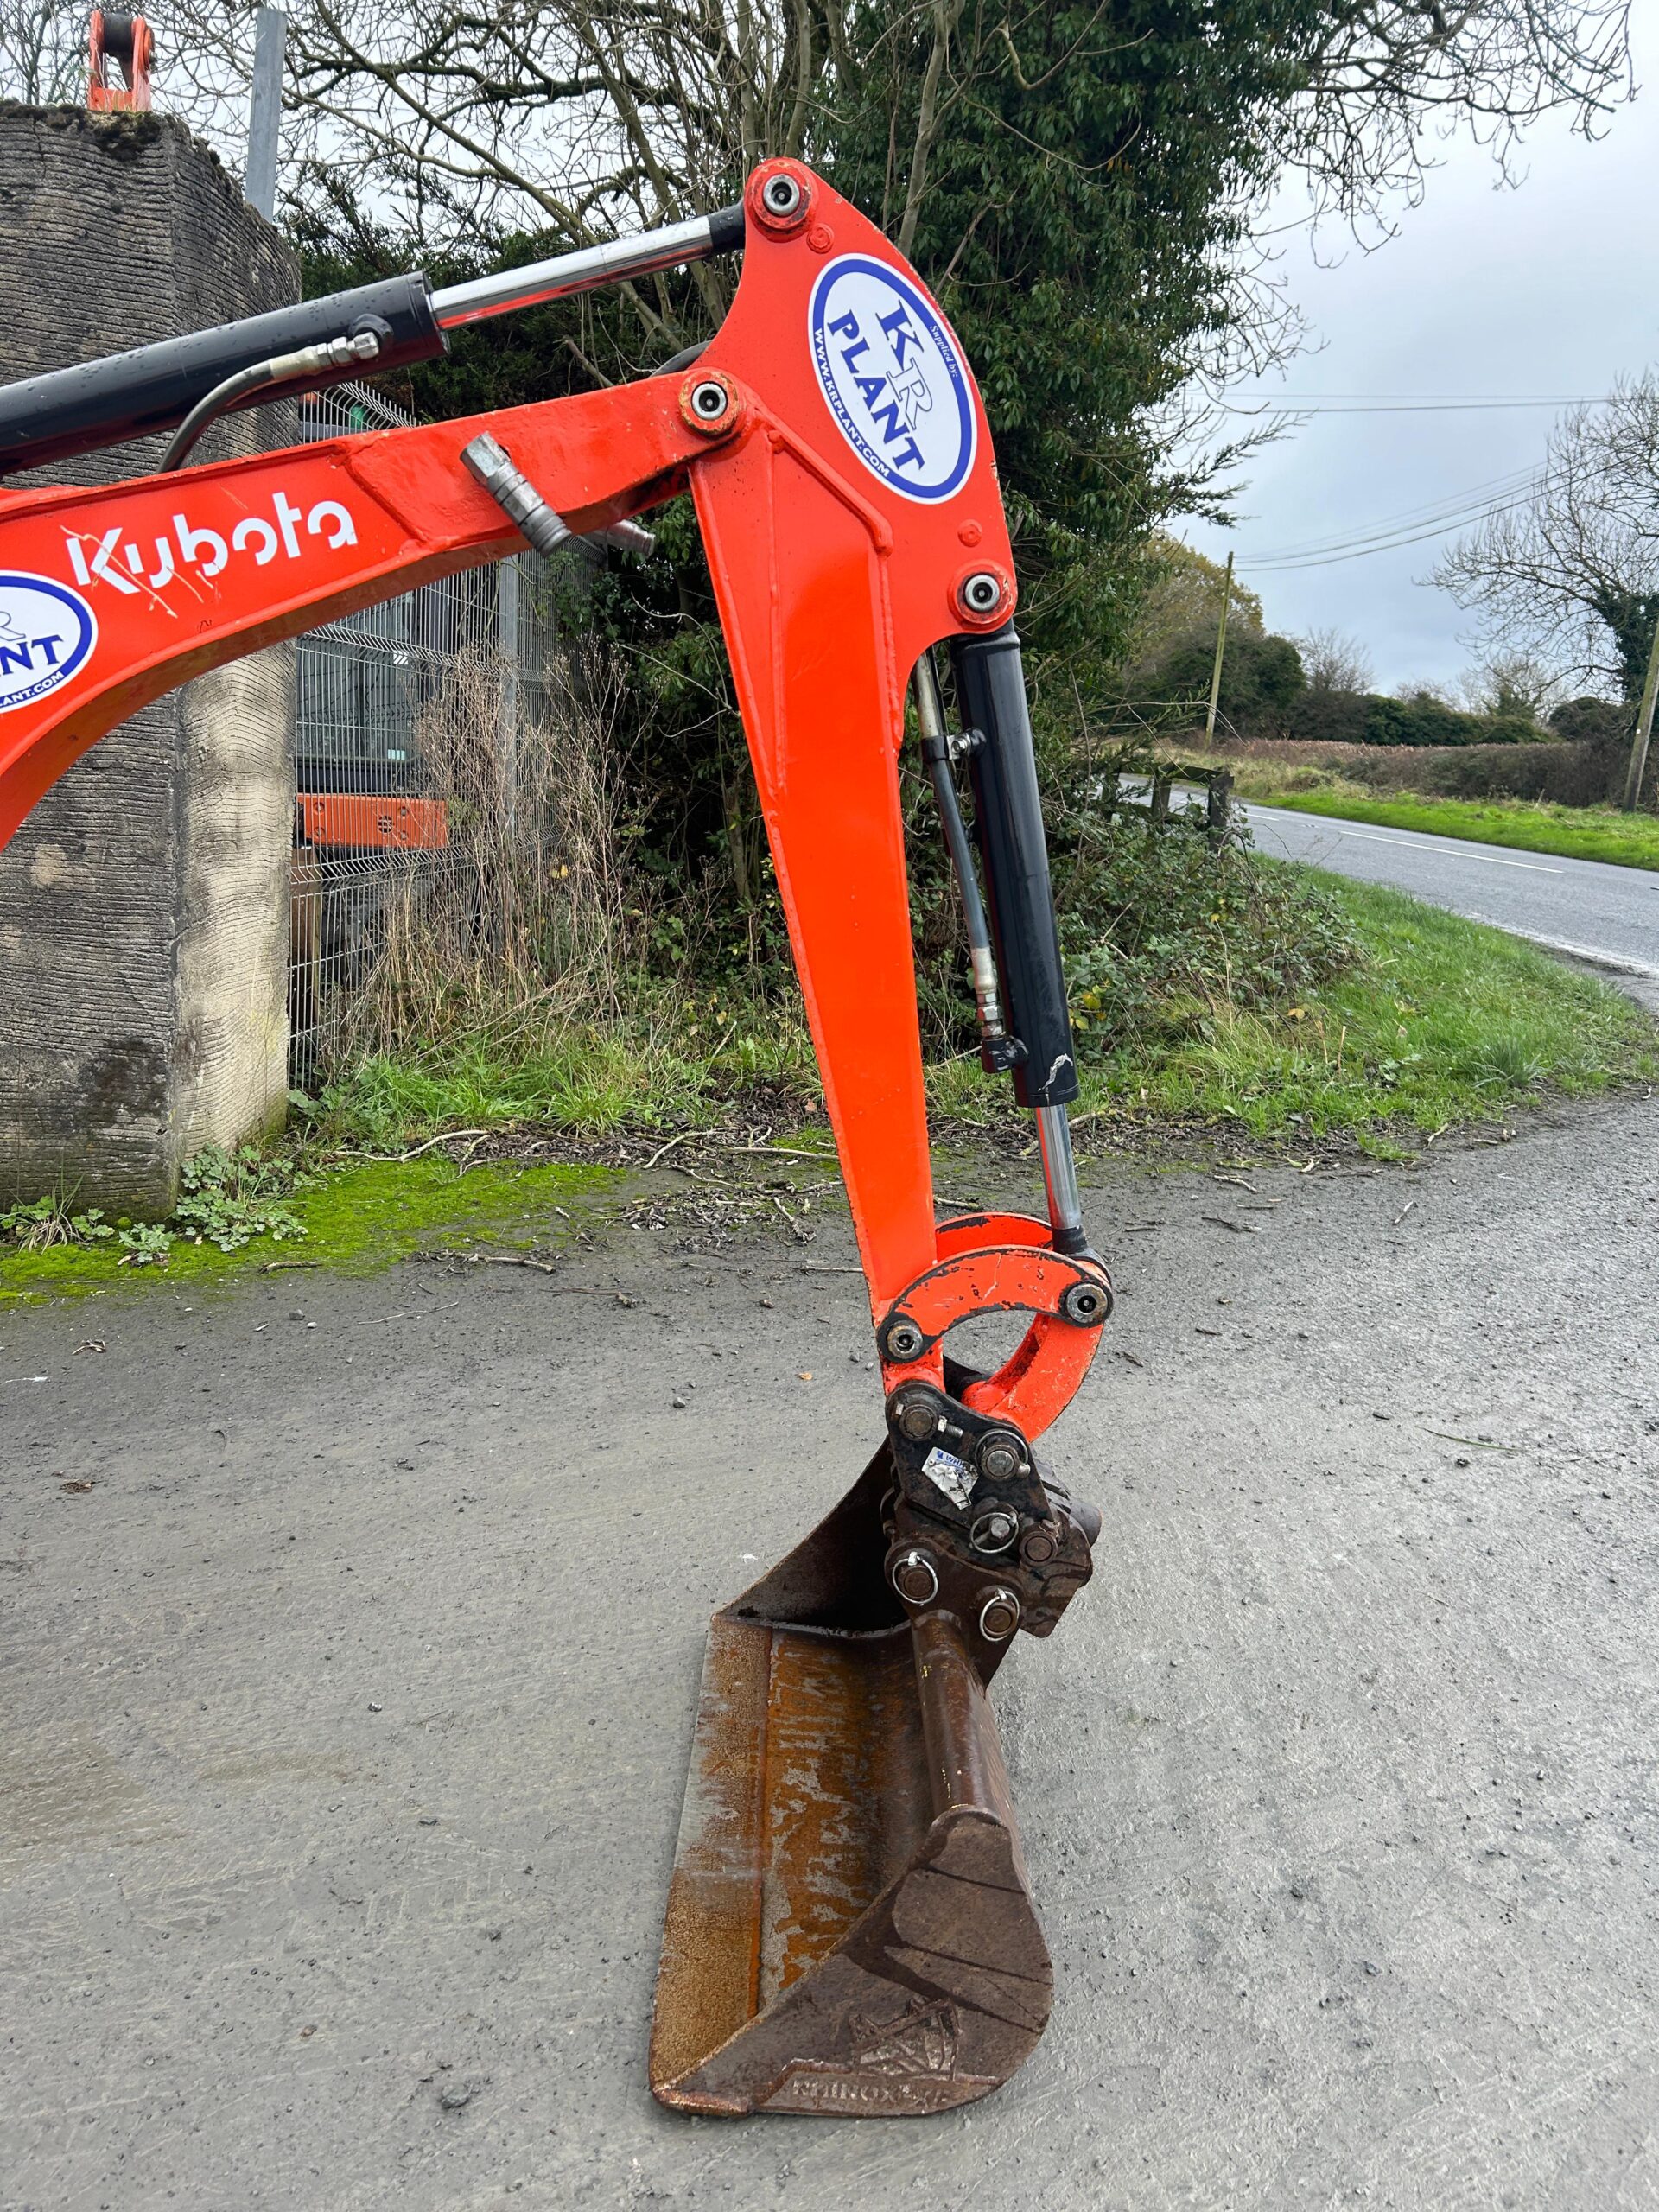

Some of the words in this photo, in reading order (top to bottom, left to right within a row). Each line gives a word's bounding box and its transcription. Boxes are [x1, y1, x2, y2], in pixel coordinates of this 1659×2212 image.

[814, 327, 890, 478] WWW.KRPLANT.COM
[827, 309, 925, 471] PLANT
[930, 325, 953, 363] Supplied
[947, 363, 959, 378] by:
[66, 491, 359, 595] Kubota
[0, 634, 64, 676] NT
